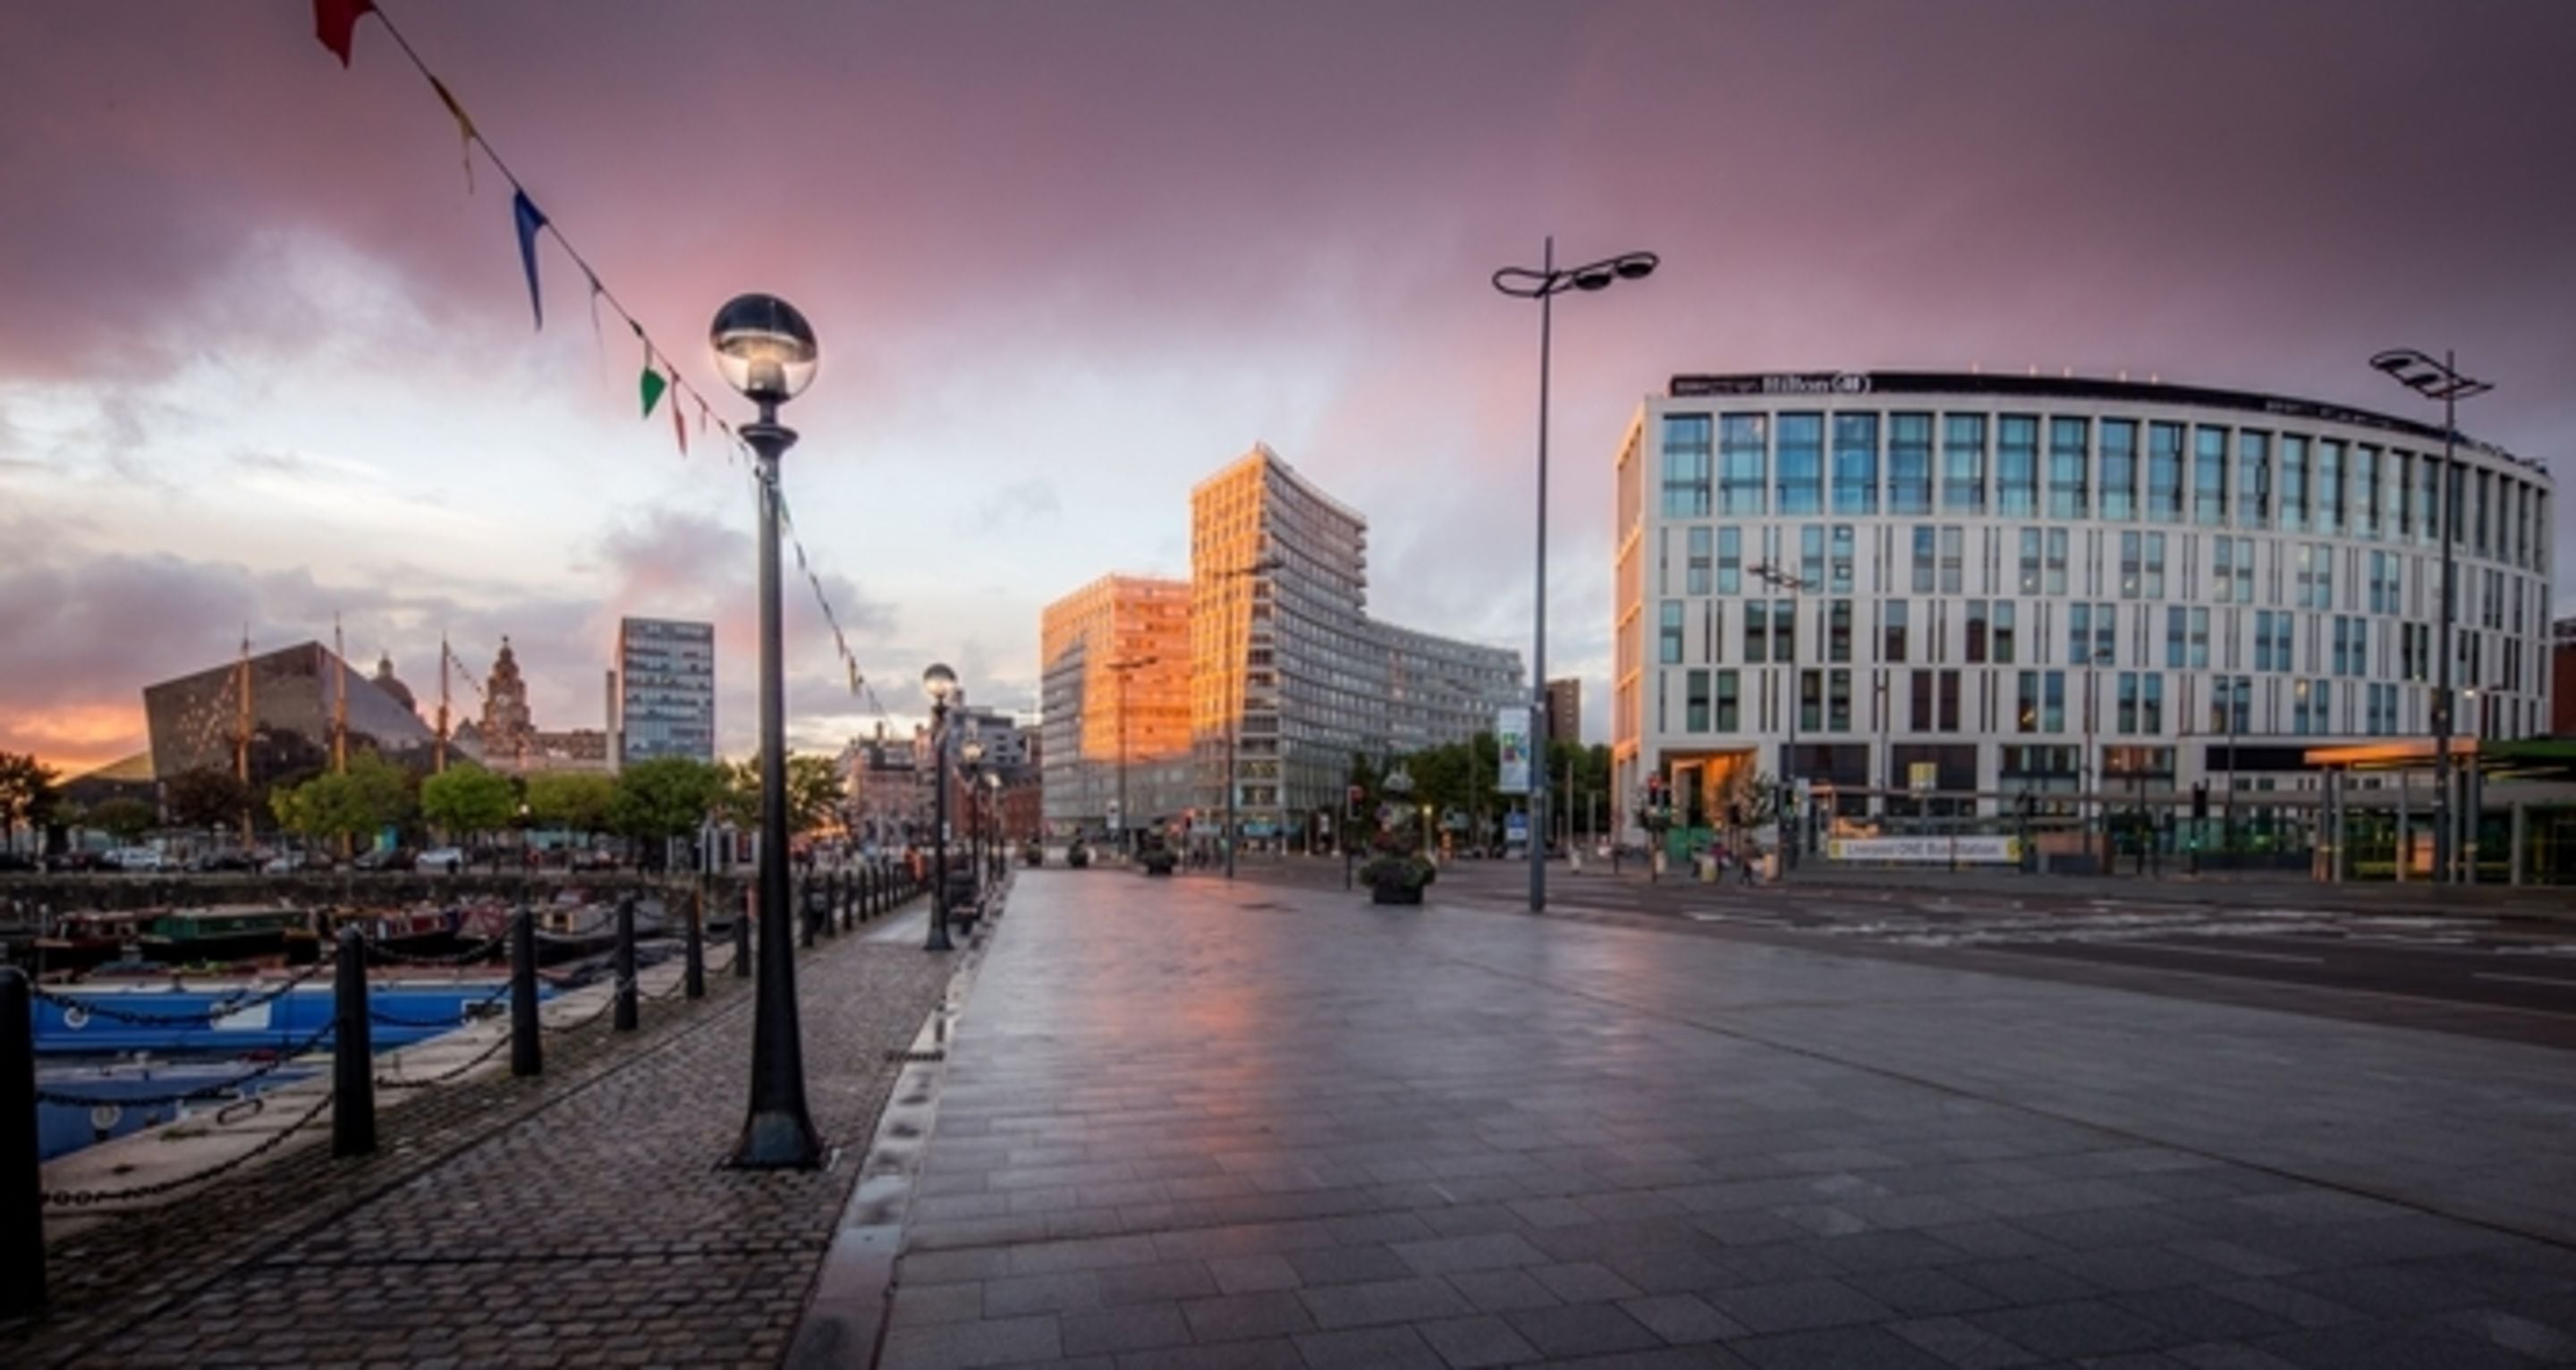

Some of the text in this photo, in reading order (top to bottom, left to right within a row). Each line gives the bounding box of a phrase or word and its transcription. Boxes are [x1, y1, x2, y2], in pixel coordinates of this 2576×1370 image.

[1762, 376, 1829, 393] Hilton
[1847, 842, 1895, 858] Liverpool
[1898, 842, 1923, 856] ONE
[1928, 842, 1949, 856] Bus
